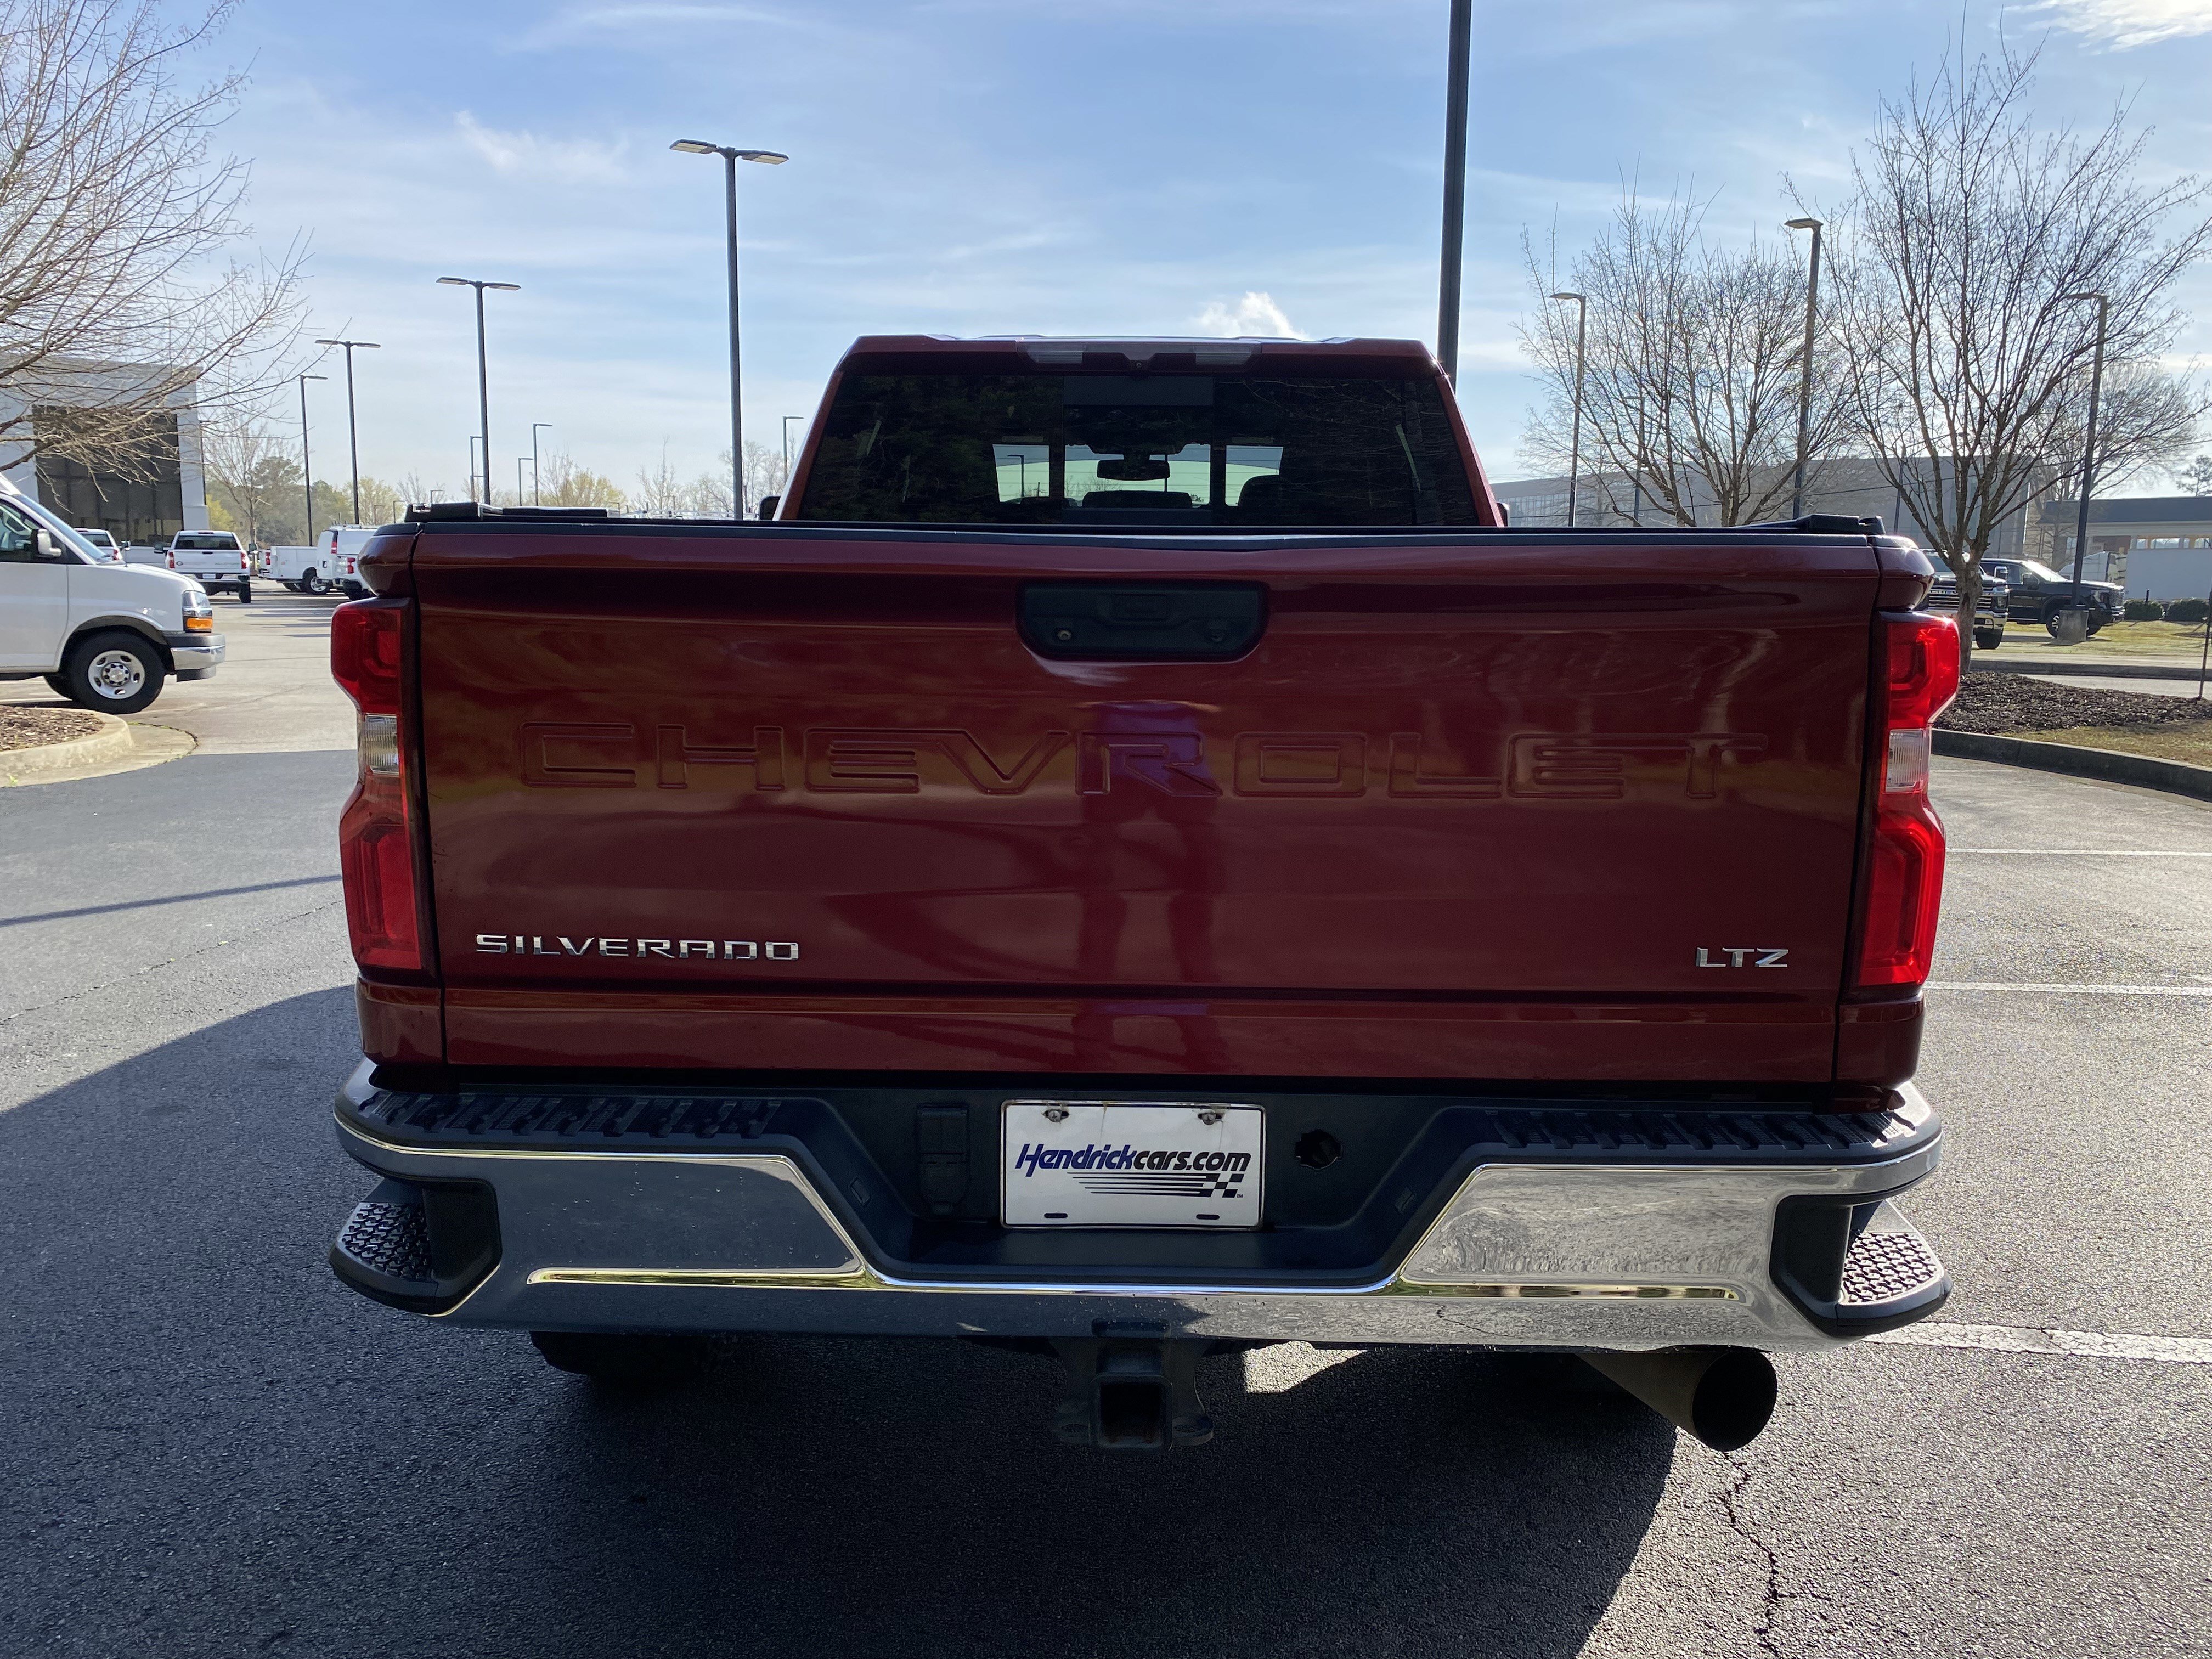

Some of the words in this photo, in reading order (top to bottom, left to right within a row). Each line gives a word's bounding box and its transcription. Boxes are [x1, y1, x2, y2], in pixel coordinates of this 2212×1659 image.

[520, 721, 1768, 799] CHEVROLET
[476, 934, 800, 961] SILVERADO
[1696, 947, 1788, 967] LTZ
[1014, 1143, 1252, 1177] Hendrickcars.com
